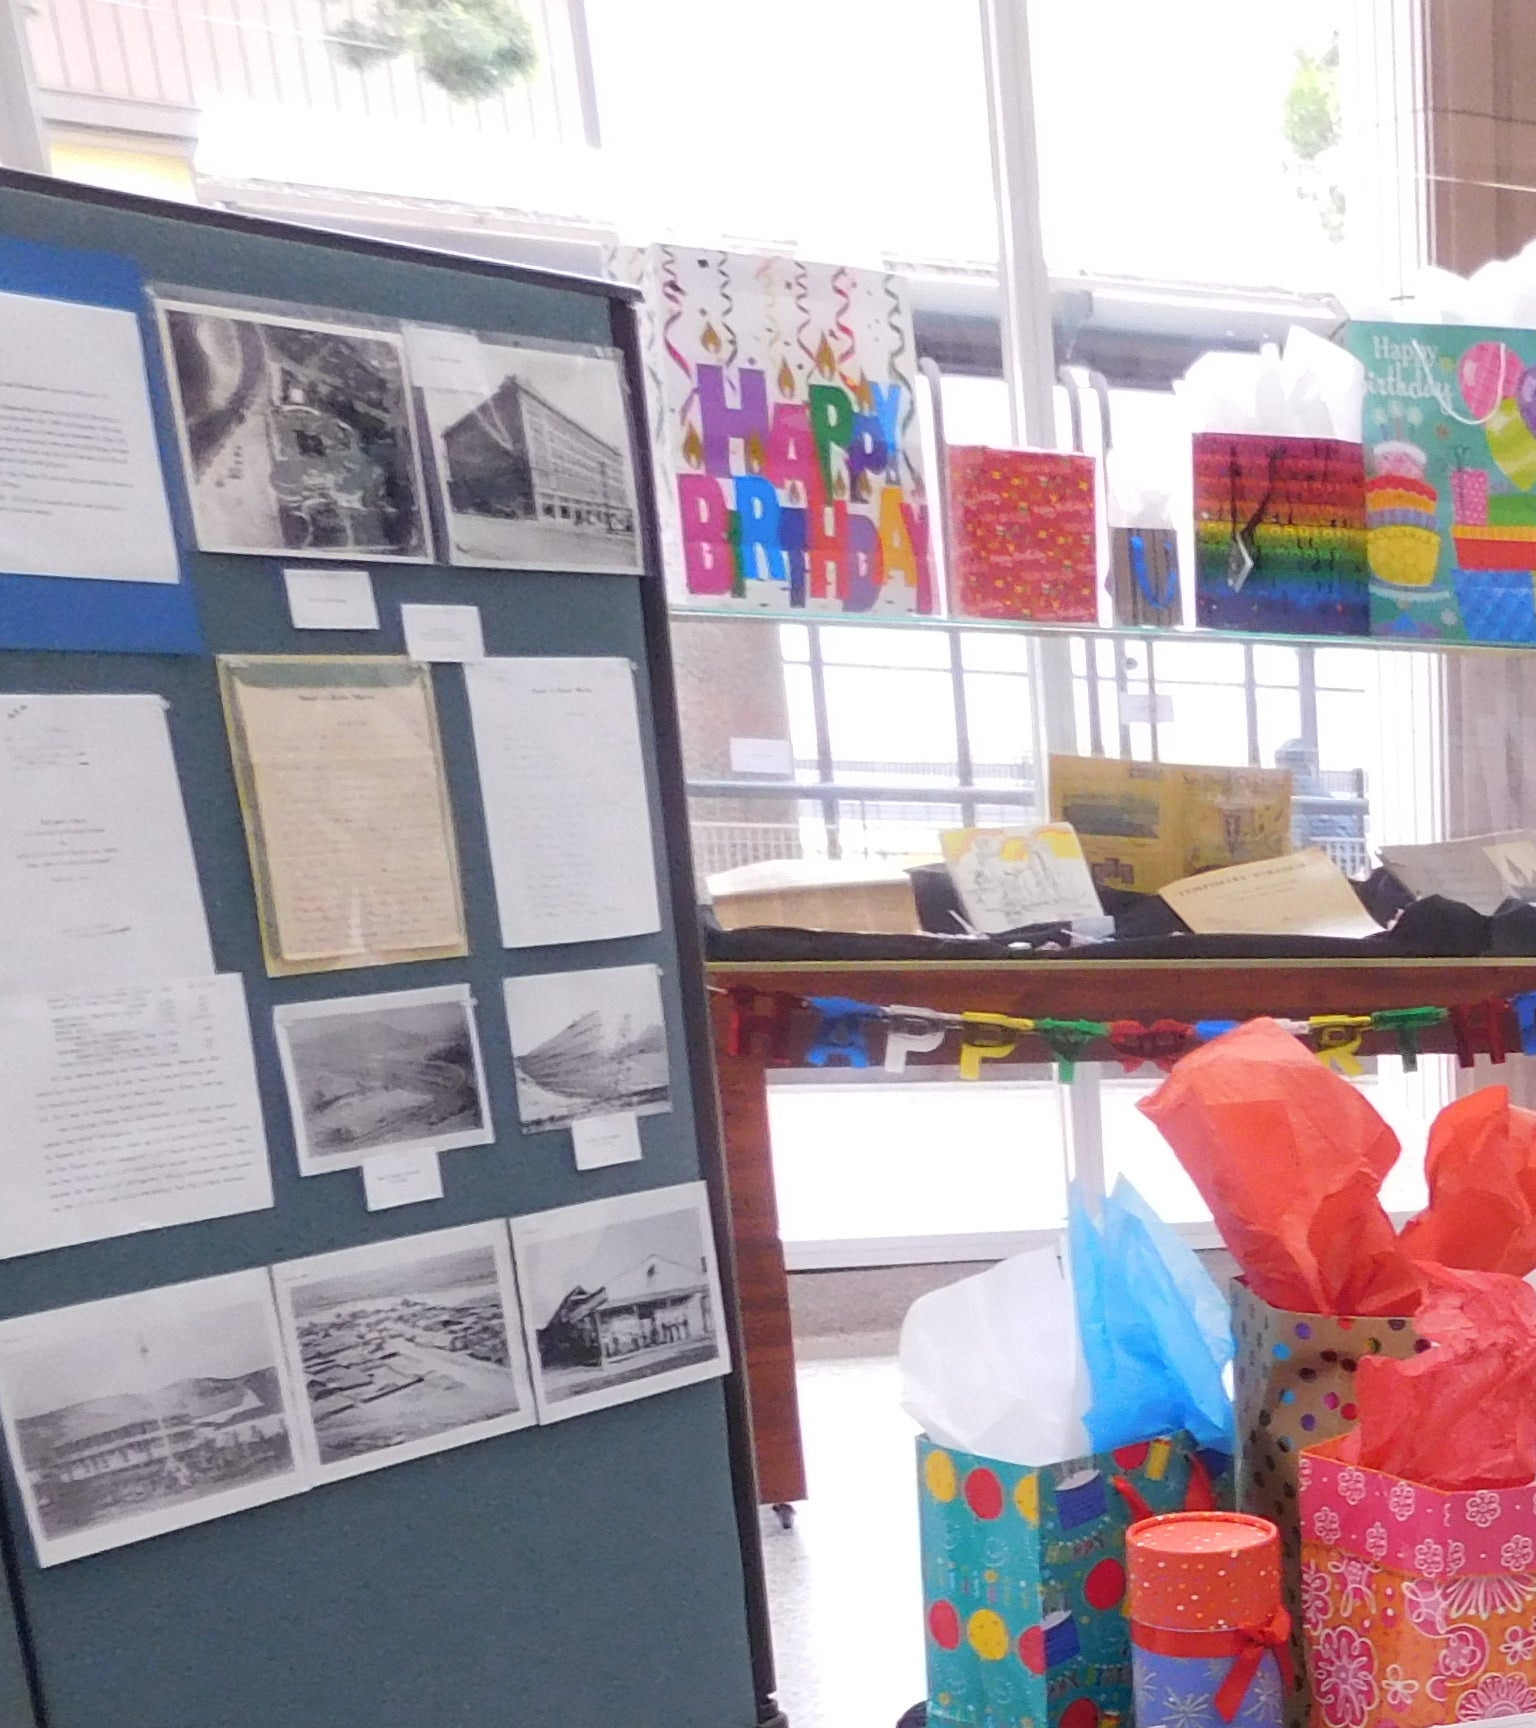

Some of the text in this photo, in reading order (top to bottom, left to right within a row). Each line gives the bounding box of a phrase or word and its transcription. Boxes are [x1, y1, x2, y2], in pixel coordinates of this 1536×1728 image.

[1366, 361, 1453, 415] irthday
[1373, 335, 1440, 368] Happy
[695, 362, 903, 506] HAPPY
[676, 473, 933, 616] BIRTHDAY
